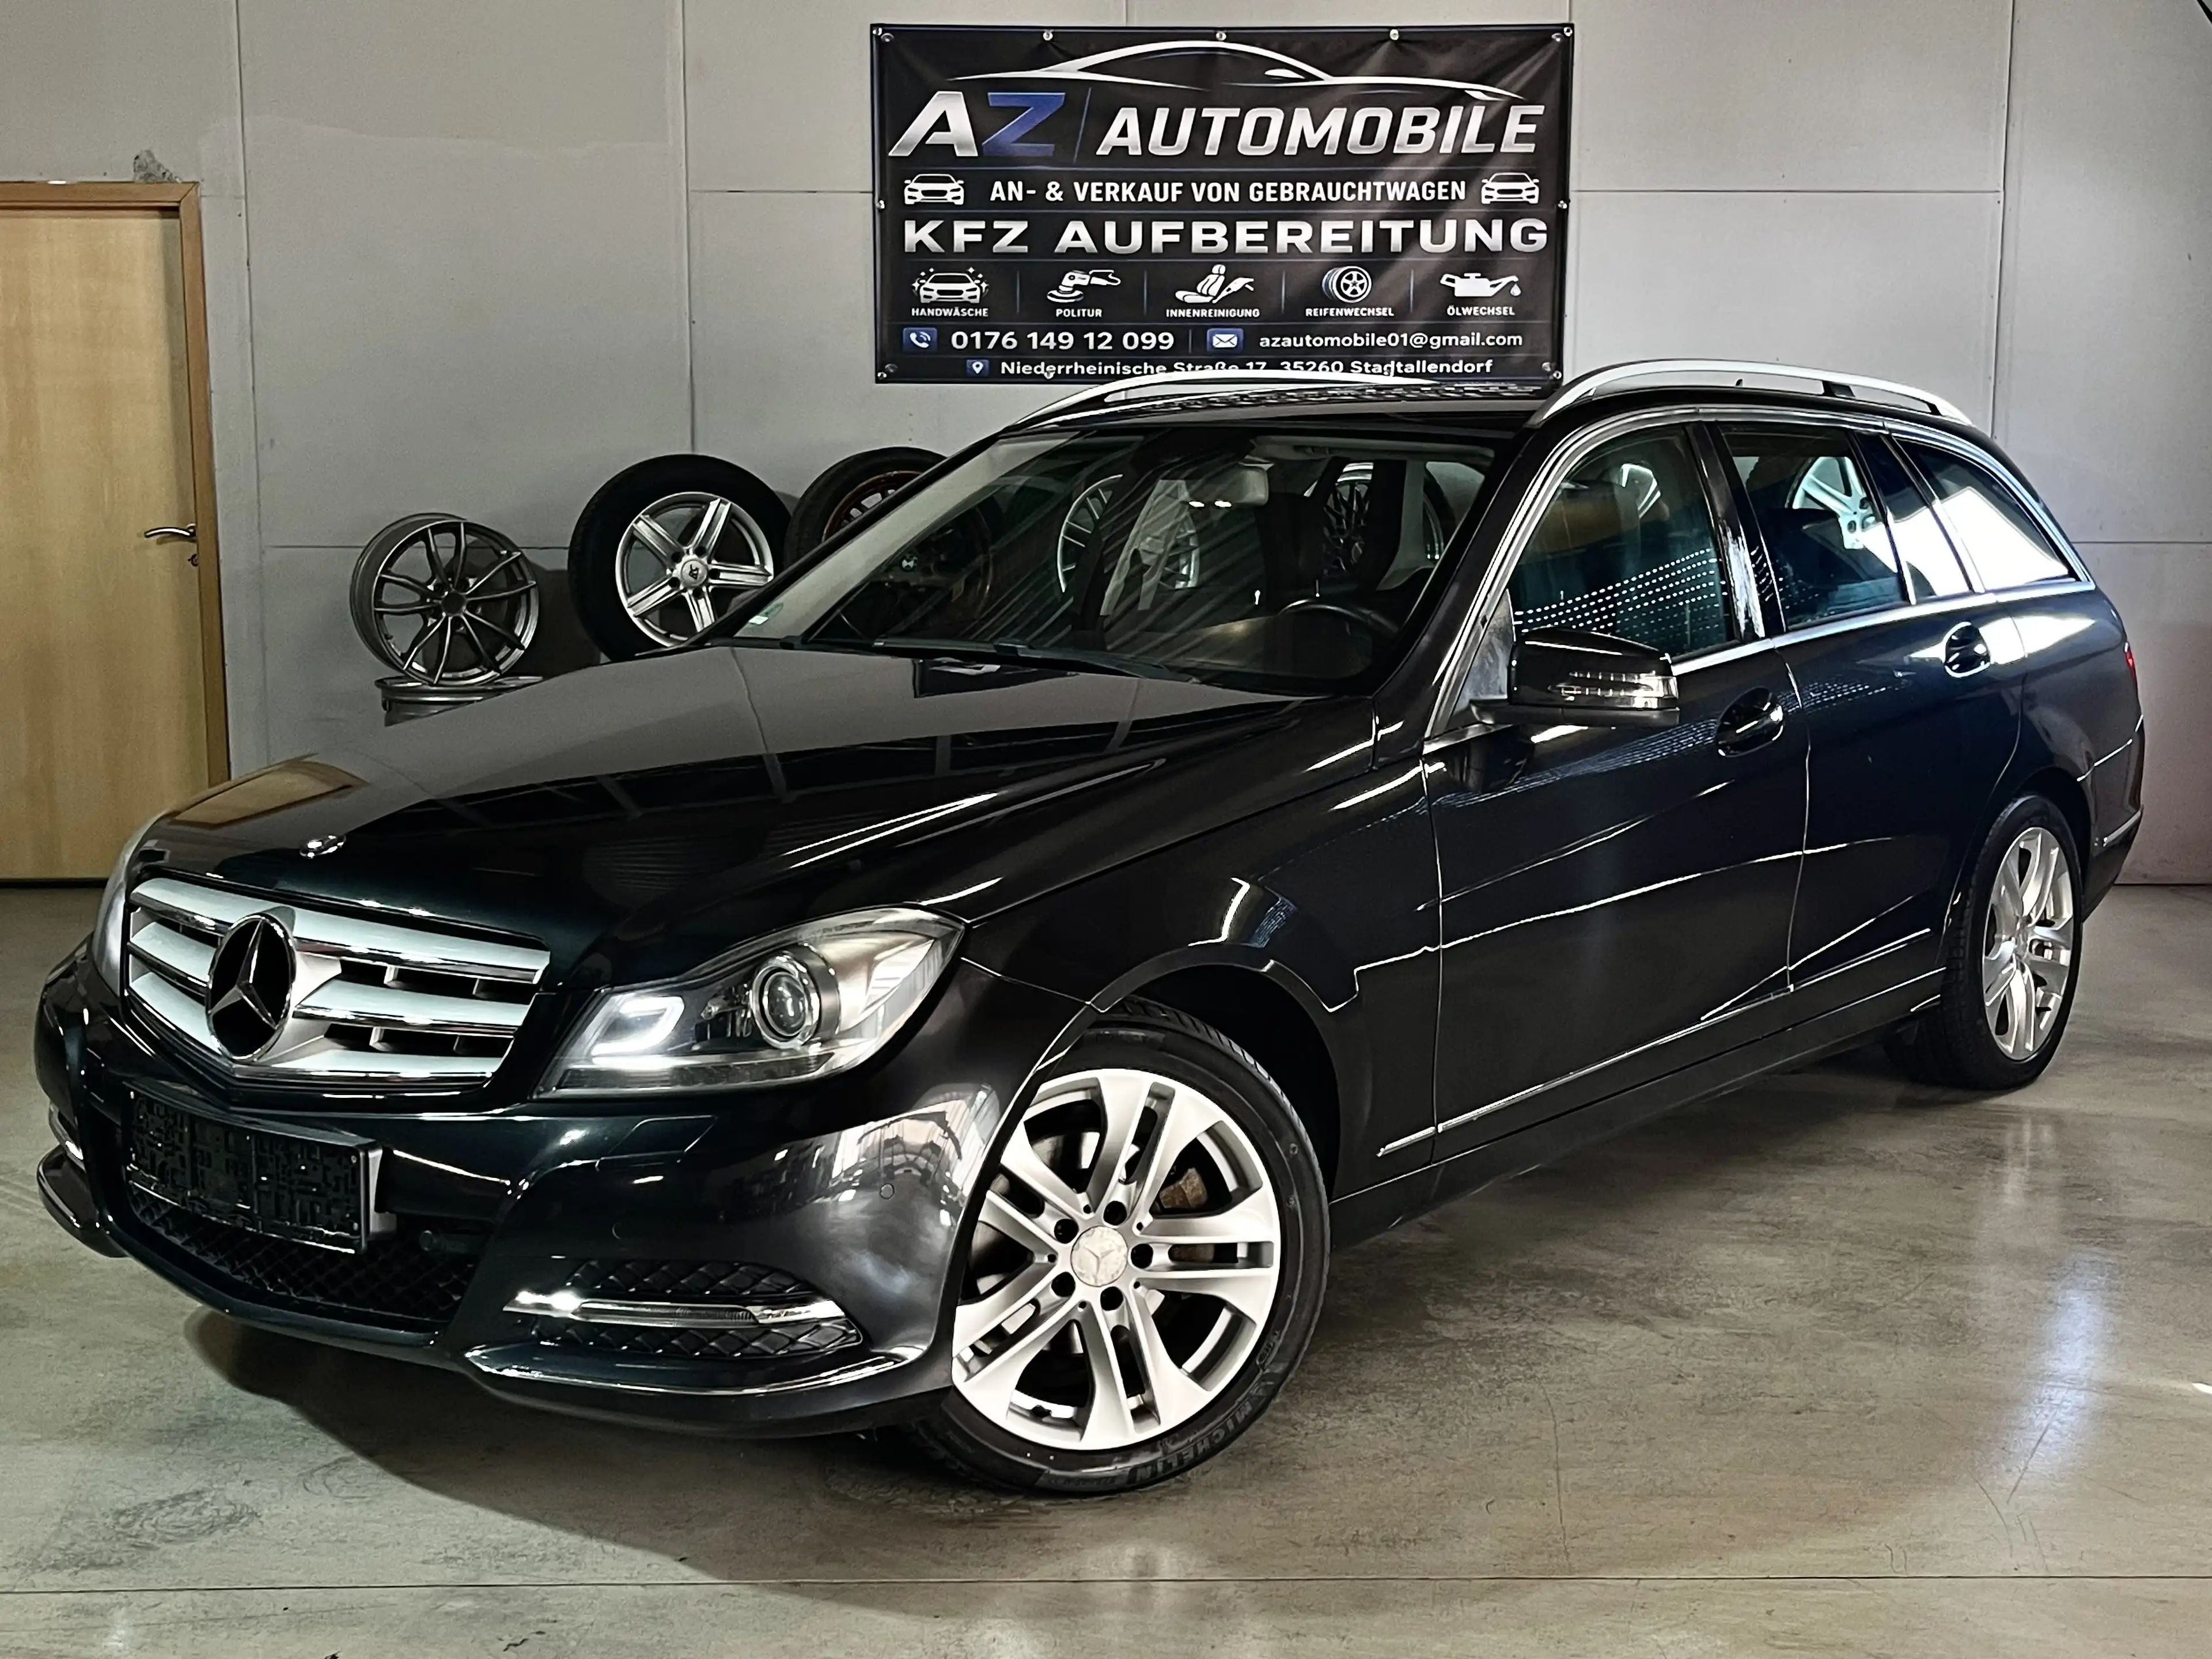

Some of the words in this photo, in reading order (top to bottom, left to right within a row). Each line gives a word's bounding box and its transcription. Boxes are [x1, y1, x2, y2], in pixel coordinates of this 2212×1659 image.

[888, 91, 1065, 156] AZ
[1096, 105, 1544, 156] AUTOMOBILE
[990, 181, 1036, 201] AN-
[1046, 181, 1063, 202] &
[1074, 181, 1183, 202] VERKAUF
[1191, 182, 1239, 202] VON
[1249, 180, 1466, 202] GEBRAUCHTWAGEN
[904, 220, 1028, 253] KFZ
[1055, 218, 1548, 253] AUFBEREITUNG
[911, 306, 988, 317] HANDWÄSCHE
[1055, 308, 1102, 317] POLITUR
[1166, 308, 1260, 317] INNENREINIGUNG
[1305, 307, 1395, 317] REIFENWECHSEL
[1446, 305, 1516, 316] ÖLWECHSEL
[951, 331, 1018, 349] 0176
[1027, 331, 1074, 350] 149
[1084, 332, 1113, 350] 12
[1123, 332, 1174, 350] 099
[1259, 332, 1522, 350] azautomobile01@gmail.com
[1001, 361, 1167, 375] Niederrheinische
[1280, 361, 1344, 373] 35260
[1350, 359, 1493, 376] Stadtallendorf
[1136, 1402, 1252, 1482] MICHELIN
